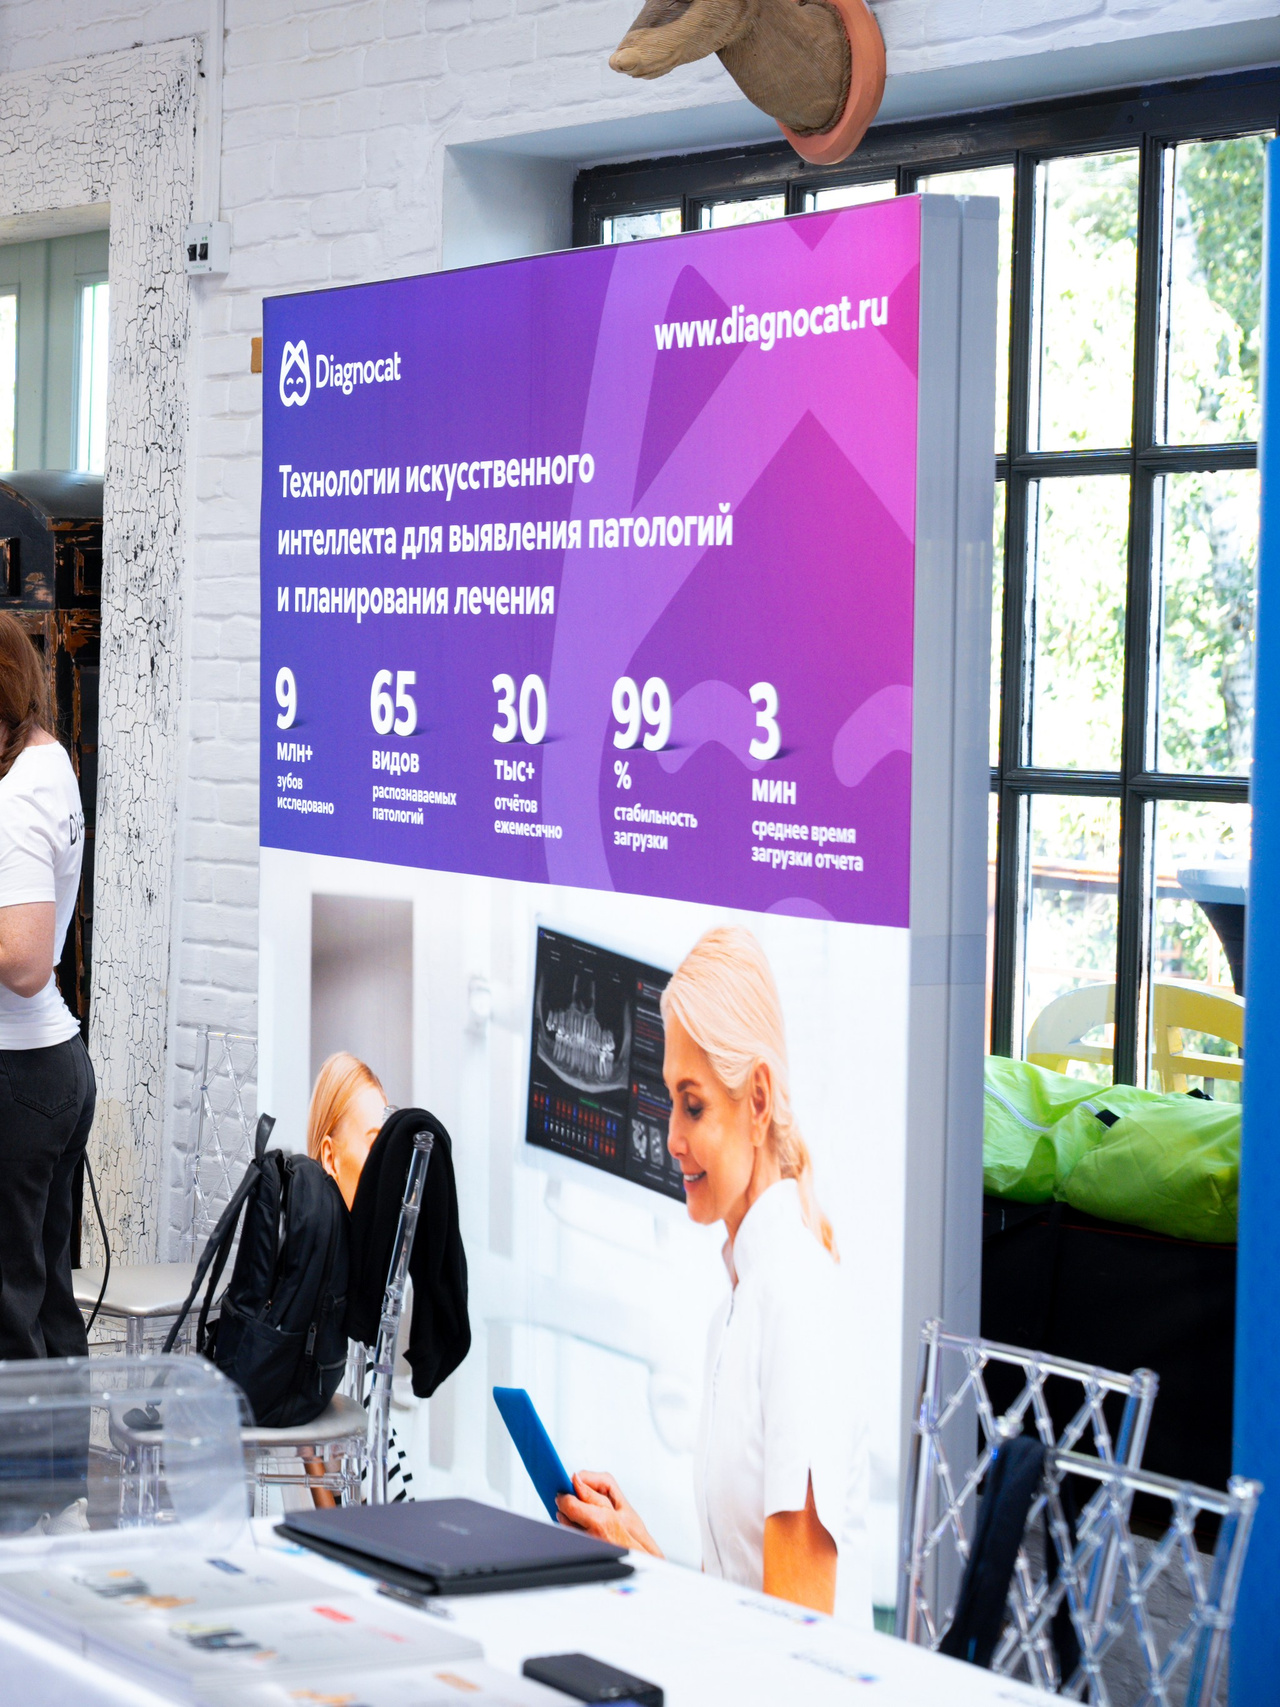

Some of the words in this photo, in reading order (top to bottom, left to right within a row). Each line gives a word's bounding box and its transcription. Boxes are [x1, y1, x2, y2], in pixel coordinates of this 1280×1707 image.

[654, 295, 889, 352] www.diagnocat.ru
[315, 351, 402, 396] Diagnocat
[278, 464, 400, 499] Технологии
[405, 452, 595, 502] искусственного
[277, 526, 397, 556] интеллекта
[401, 525, 443, 560] для
[448, 519, 582, 553] выявления
[588, 502, 733, 549] патологий
[277, 586, 290, 612] и
[294, 586, 449, 624] планирования
[453, 585, 555, 615] лечения
[275, 666, 297, 730] 9
[370, 669, 418, 737] 65
[491, 673, 548, 745] 30
[611, 676, 672, 752] 99
[748, 681, 781, 761] 3
[276, 772, 303, 792] зубов
[613, 760, 632, 790] %
[277, 796, 335, 815] исследовано
[373, 785, 457, 806] распознаваемых
[494, 793, 538, 814] отчётов
[372, 807, 424, 825] патологий
[494, 819, 563, 840] ежемесячно
[613, 802, 698, 829] стабильность
[613, 830, 669, 853] загрузки
[752, 820, 809, 841] среднее
[811, 826, 856, 847] время
[751, 846, 813, 870] загрузки
[815, 853, 864, 872] отчета
